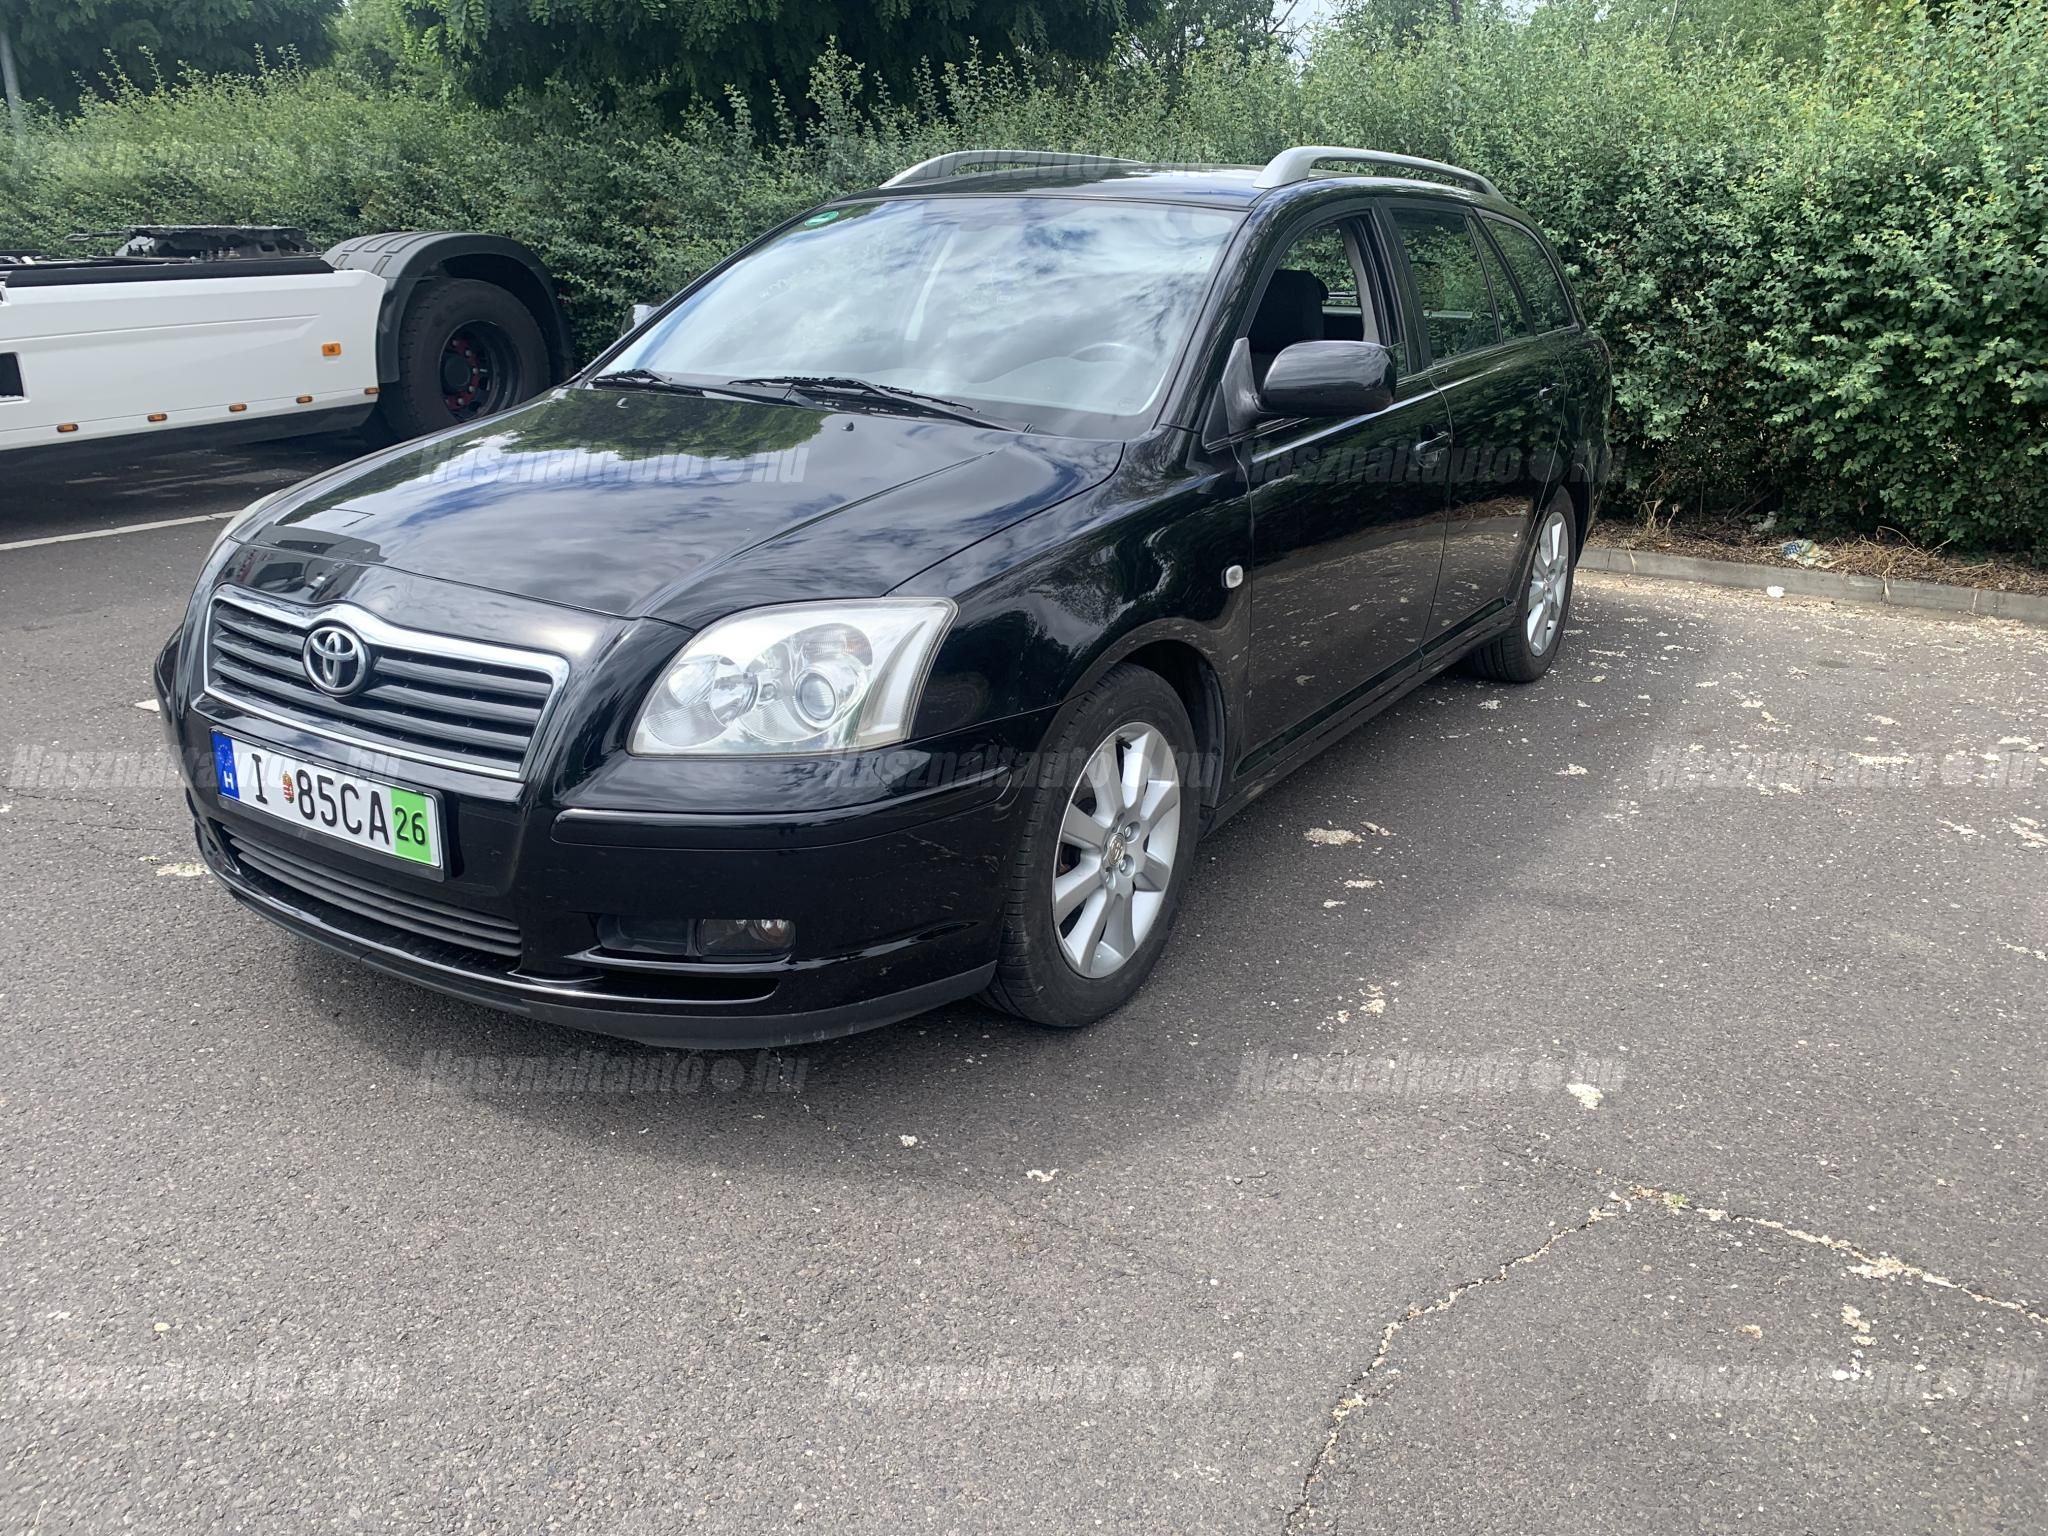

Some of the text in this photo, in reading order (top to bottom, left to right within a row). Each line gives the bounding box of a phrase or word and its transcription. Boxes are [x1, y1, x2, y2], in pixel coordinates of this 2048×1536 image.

[223, 771, 236, 790] H
[296, 769, 390, 846] 85CA
[394, 807, 426, 846] 26
